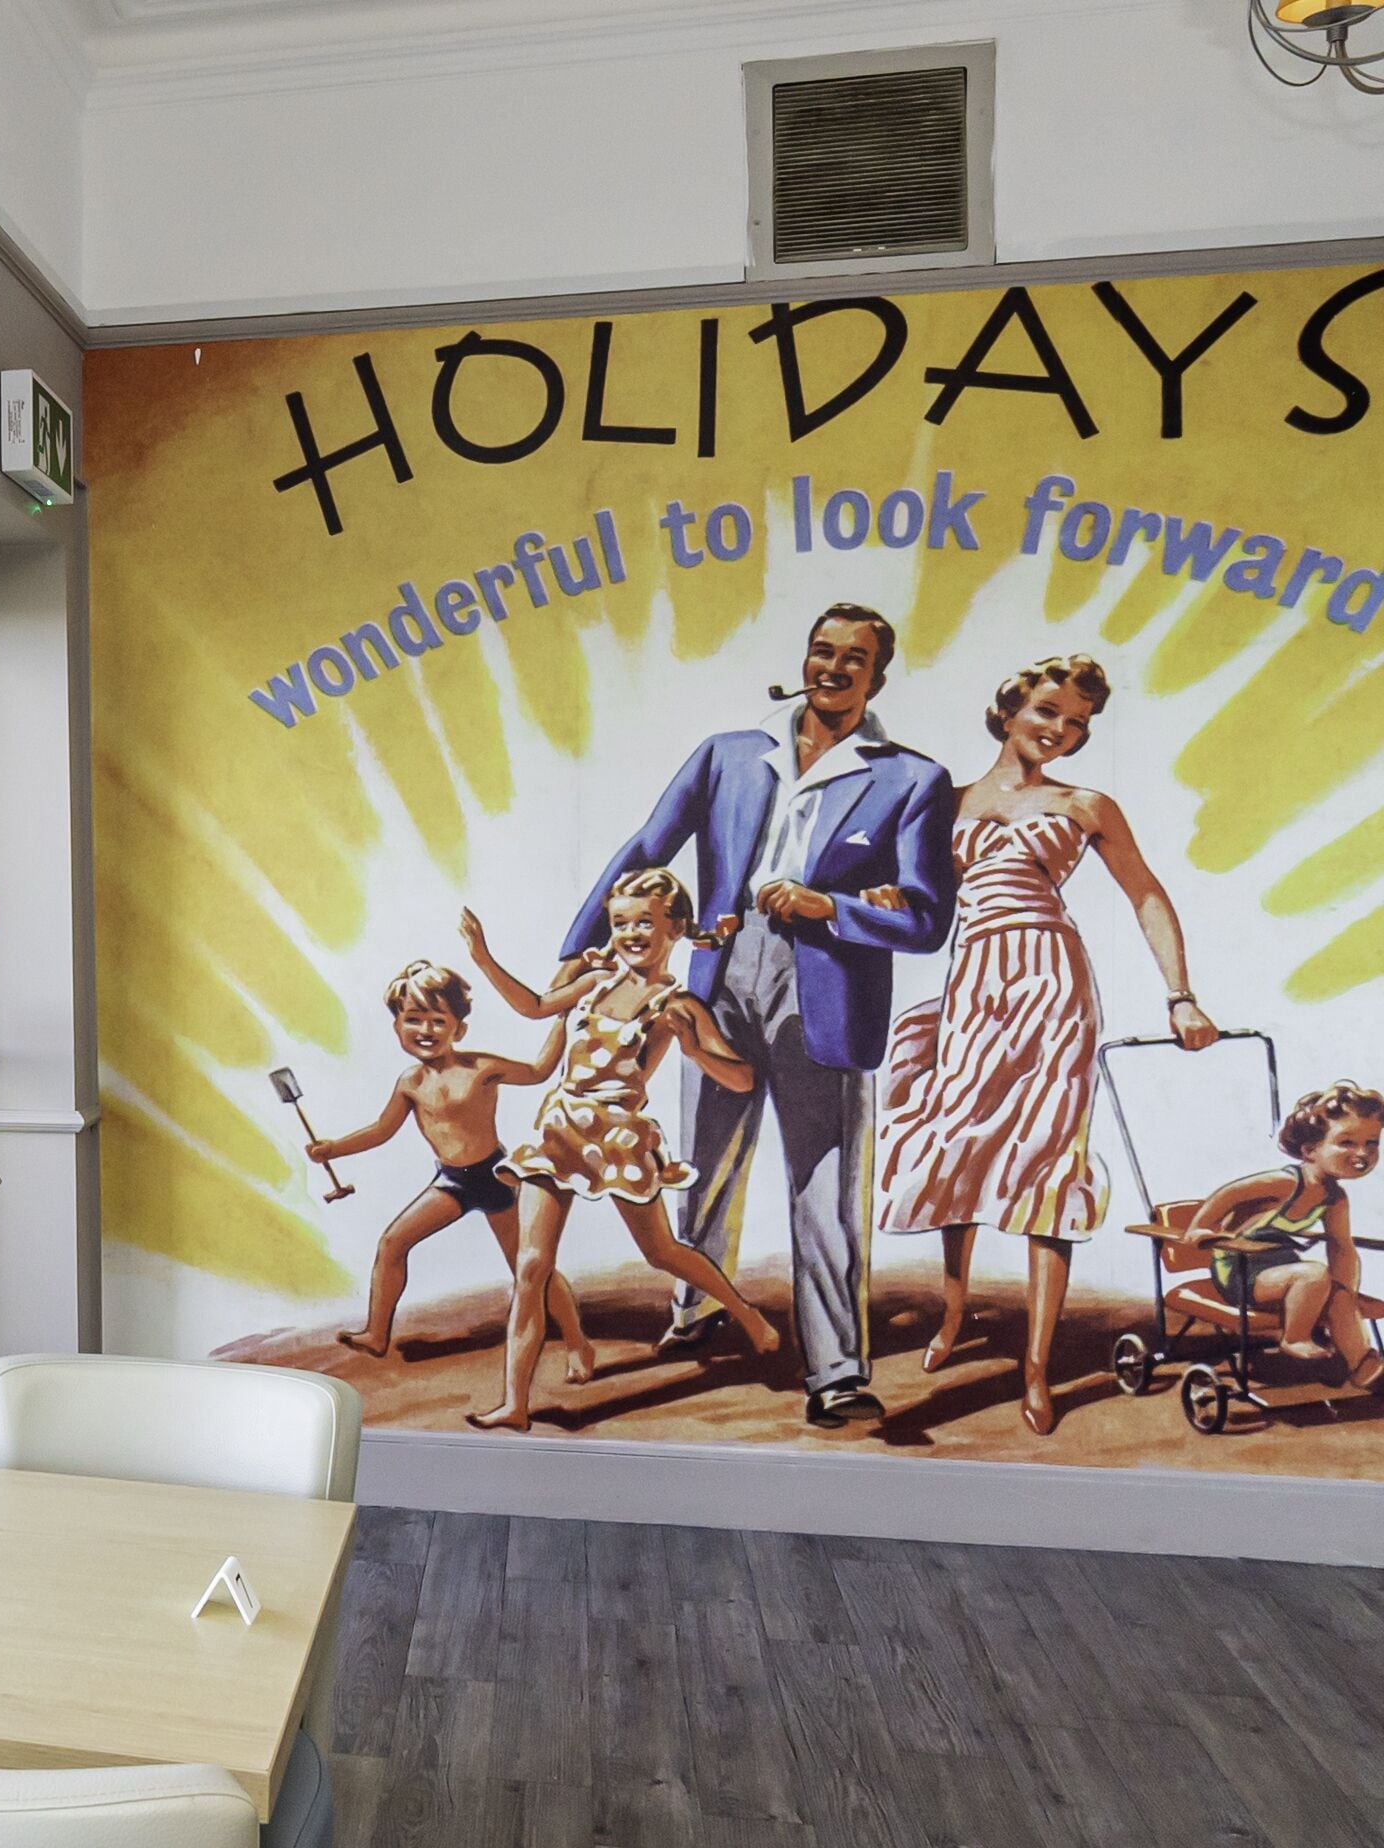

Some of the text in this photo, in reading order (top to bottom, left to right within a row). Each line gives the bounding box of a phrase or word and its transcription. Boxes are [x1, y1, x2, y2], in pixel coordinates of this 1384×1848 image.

[272, 269, 1384, 536] HOLIDAYS
[247, 470, 1384, 730] wonderful to look forward
